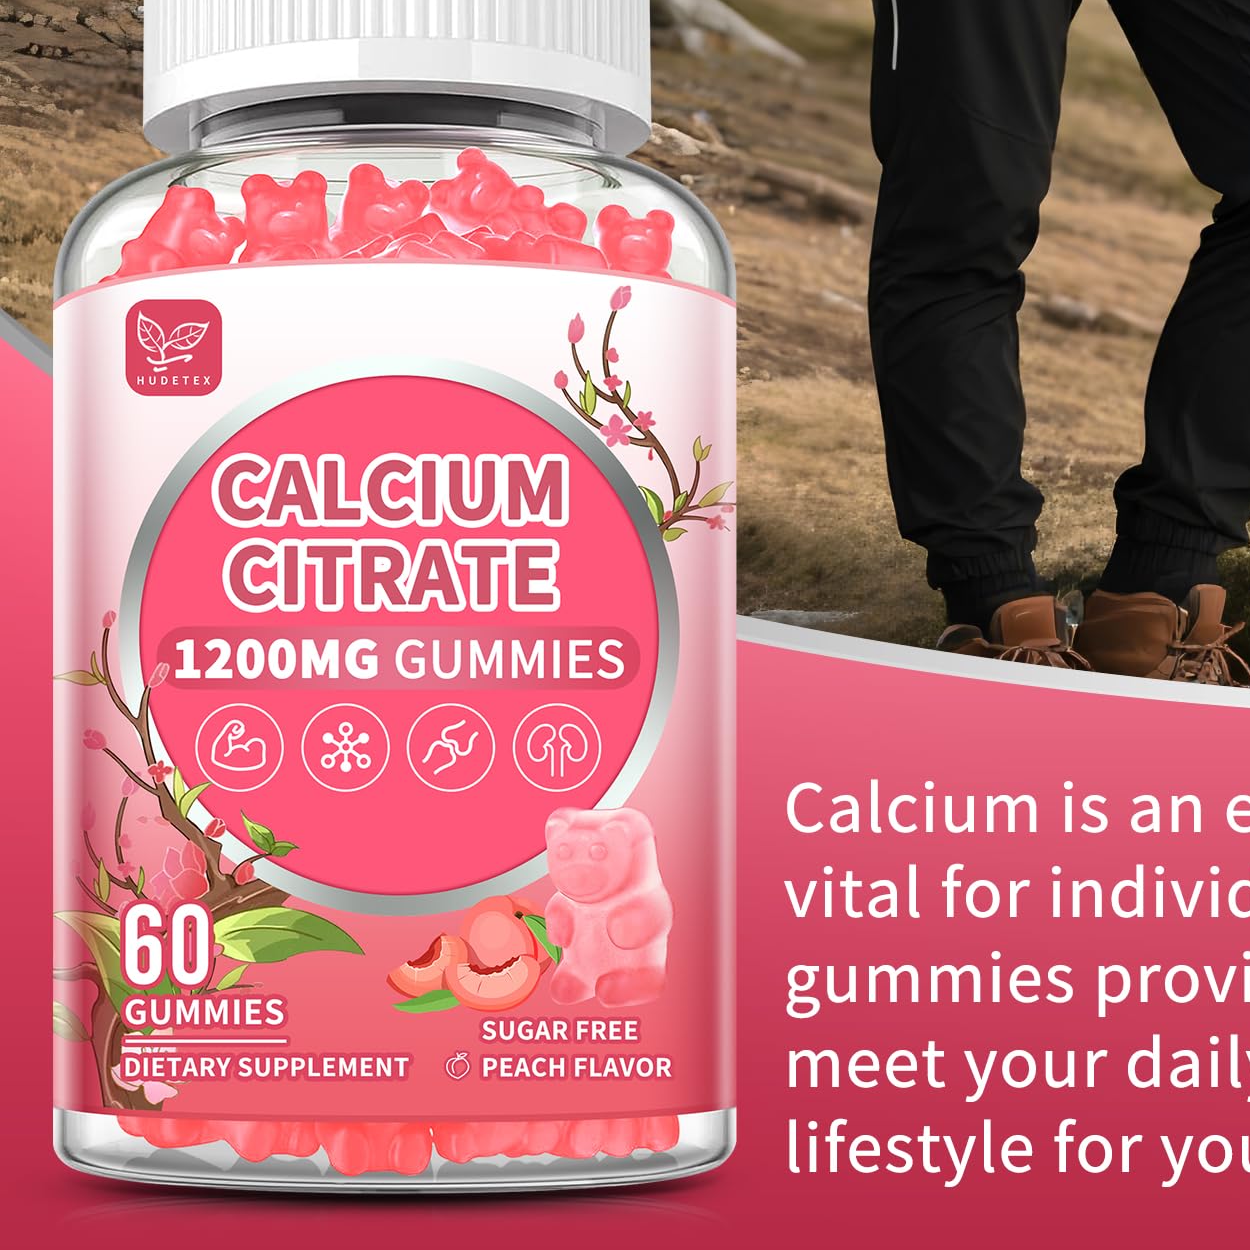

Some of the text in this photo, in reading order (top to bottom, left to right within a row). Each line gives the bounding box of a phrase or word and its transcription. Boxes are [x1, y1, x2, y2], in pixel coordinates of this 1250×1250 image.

[136, 374, 212, 386] HUDETEX
[211, 452, 569, 528] CALCIUM
[222, 537, 561, 613] CITRATE
[174, 638, 625, 680] 1200MG GUMMIES
[125, 903, 209, 985] 60
[125, 998, 285, 1025] GUMMIES
[482, 1020, 638, 1041] SUGAR FREE
[125, 1057, 409, 1077] DIETARY SUPPLEMENT
[482, 1057, 672, 1077] PEACH FLAVOR
